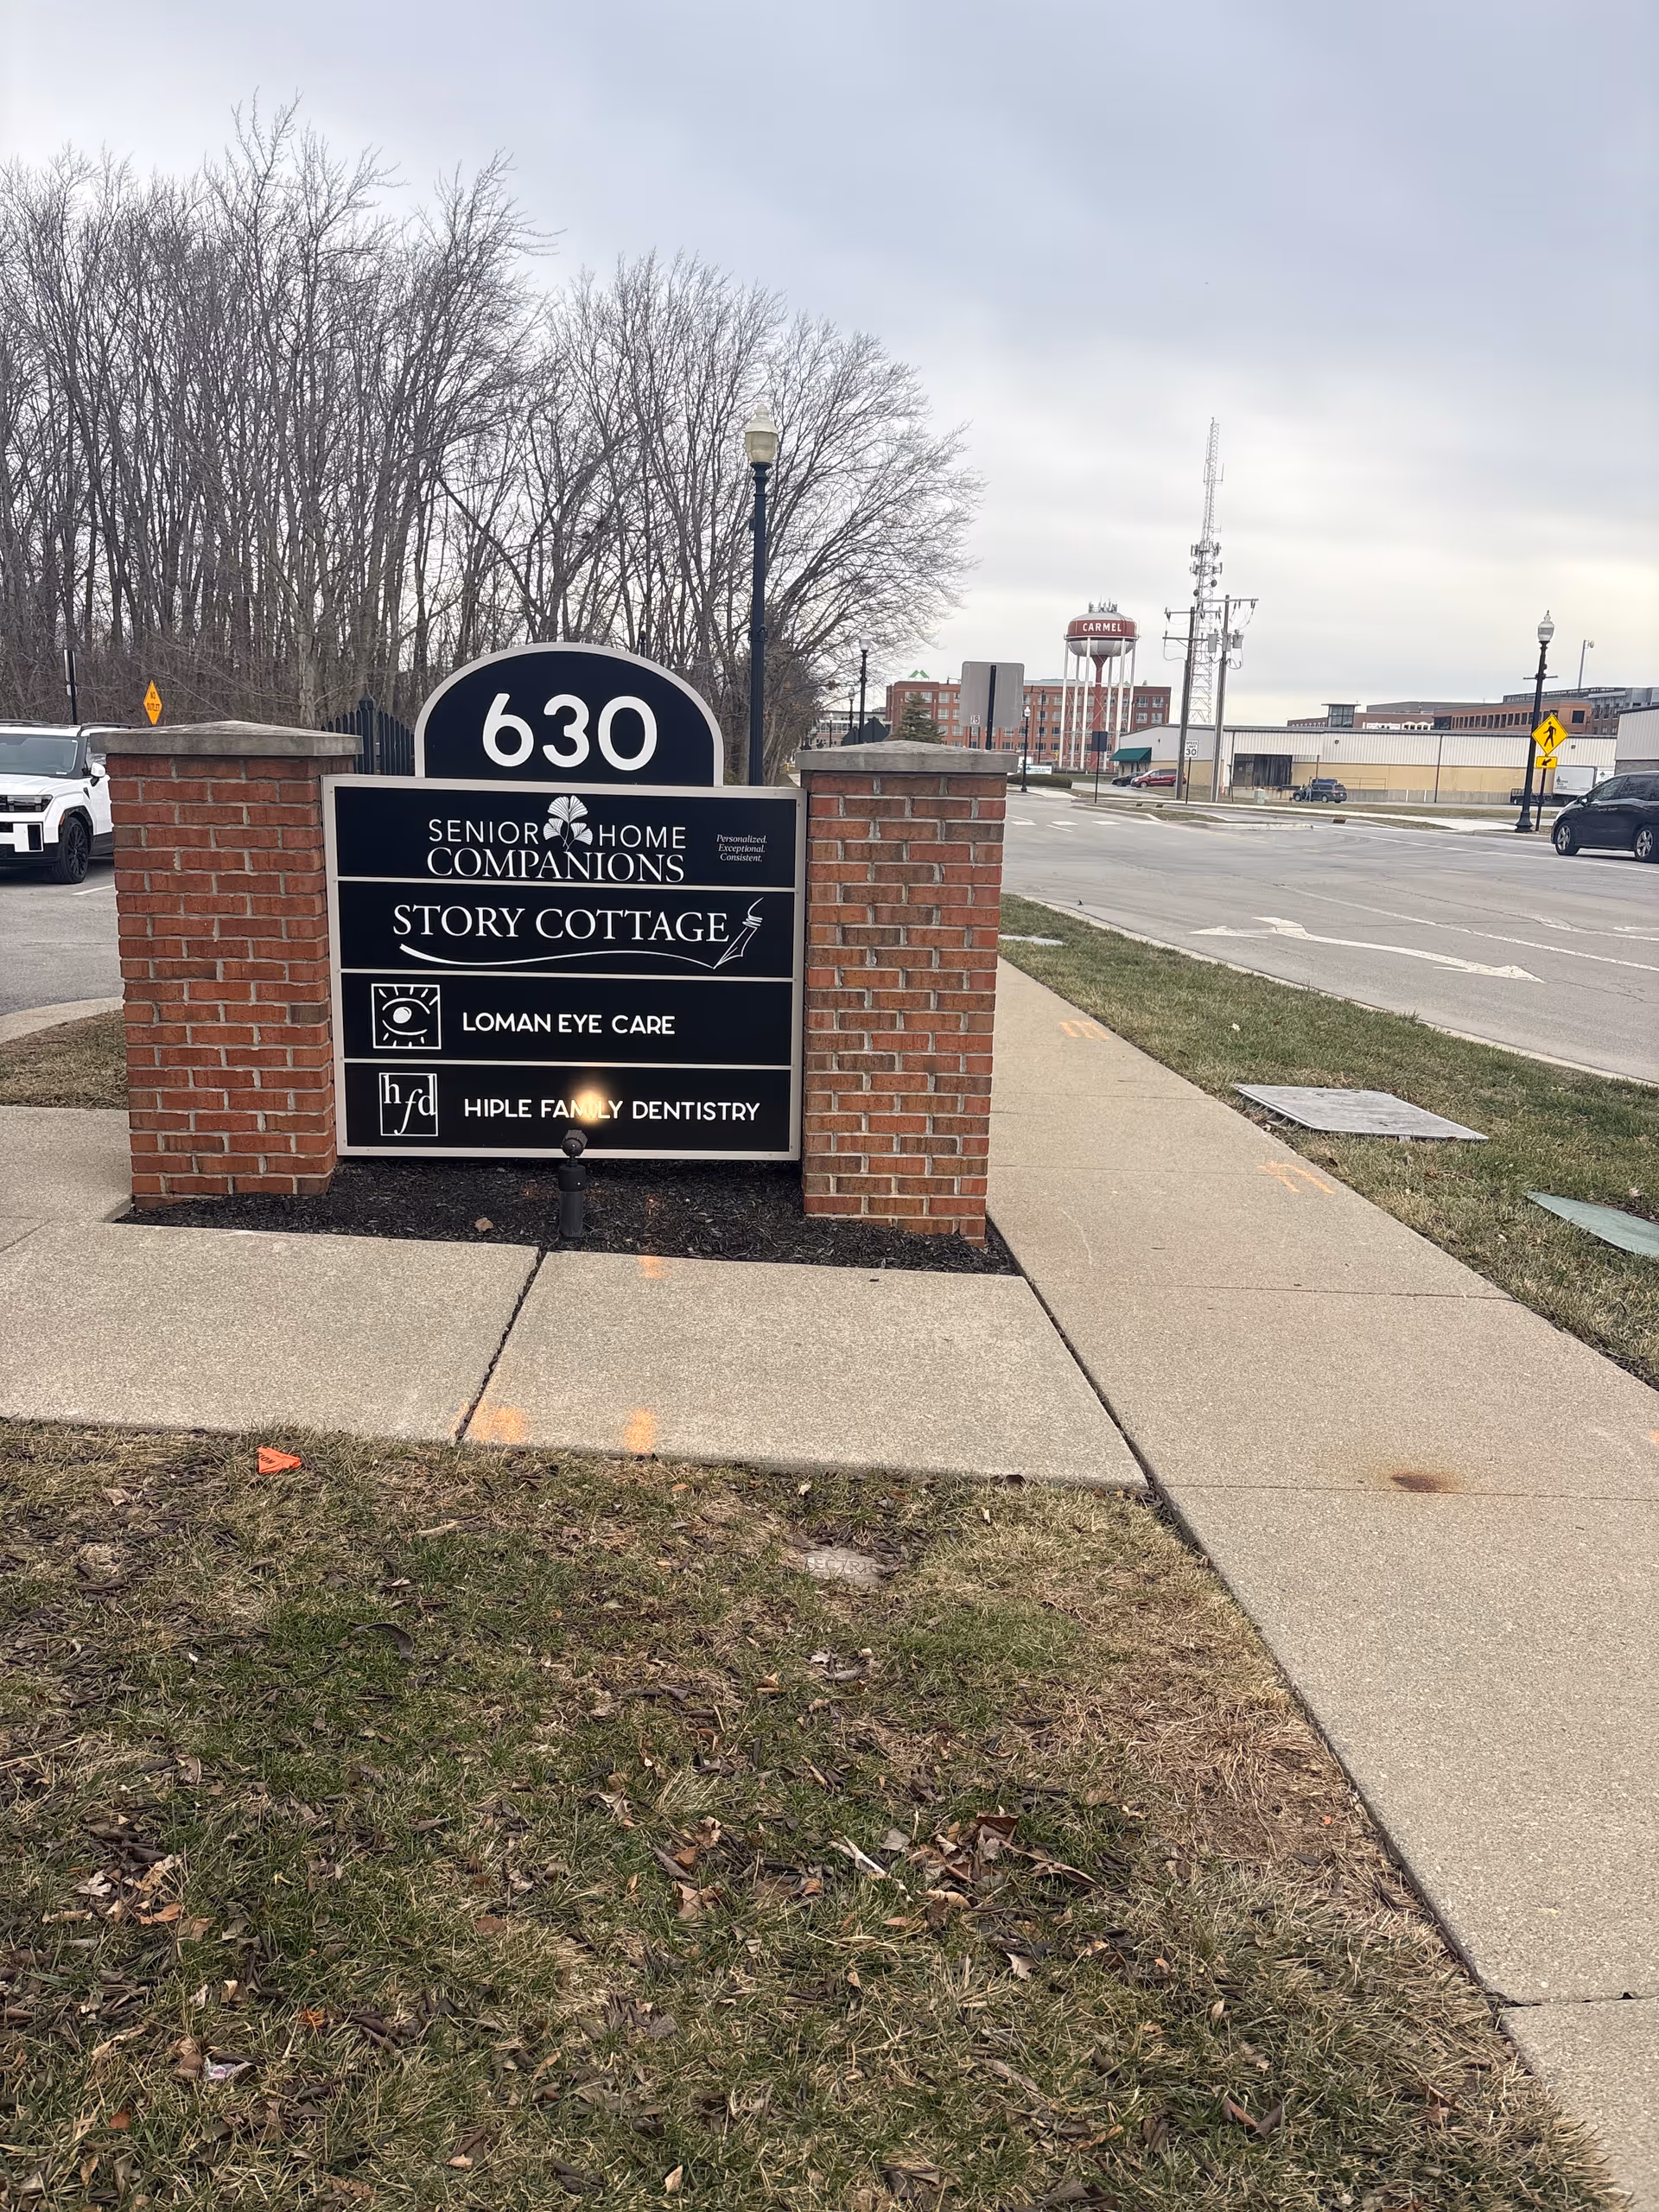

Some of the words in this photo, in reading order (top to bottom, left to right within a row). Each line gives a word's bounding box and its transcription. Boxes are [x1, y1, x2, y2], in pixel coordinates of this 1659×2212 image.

[1083, 623, 1122, 632] CARMEL
[482, 692, 658, 772] 630
[428, 818, 539, 846] SENIOR
[599, 824, 687, 849] HOME
[716, 834, 768, 844] Personalized.
[718, 843, 766, 855] Exceptional.
[720, 853, 763, 862] Consistent.
[427, 847, 685, 883] COMPANIONS
[392, 904, 526, 938] STORY
[535, 908, 730, 942] COTTAGE
[462, 1012, 551, 1033] LOMAN
[558, 1014, 603, 1033] EYE
[611, 1014, 676, 1035] CARE
[383, 1075, 436, 1135] hfd
[464, 1098, 532, 1118] HIPLE
[541, 1099, 624, 1120] FAMILY
[632, 1100, 760, 1121] DENTISTRY
